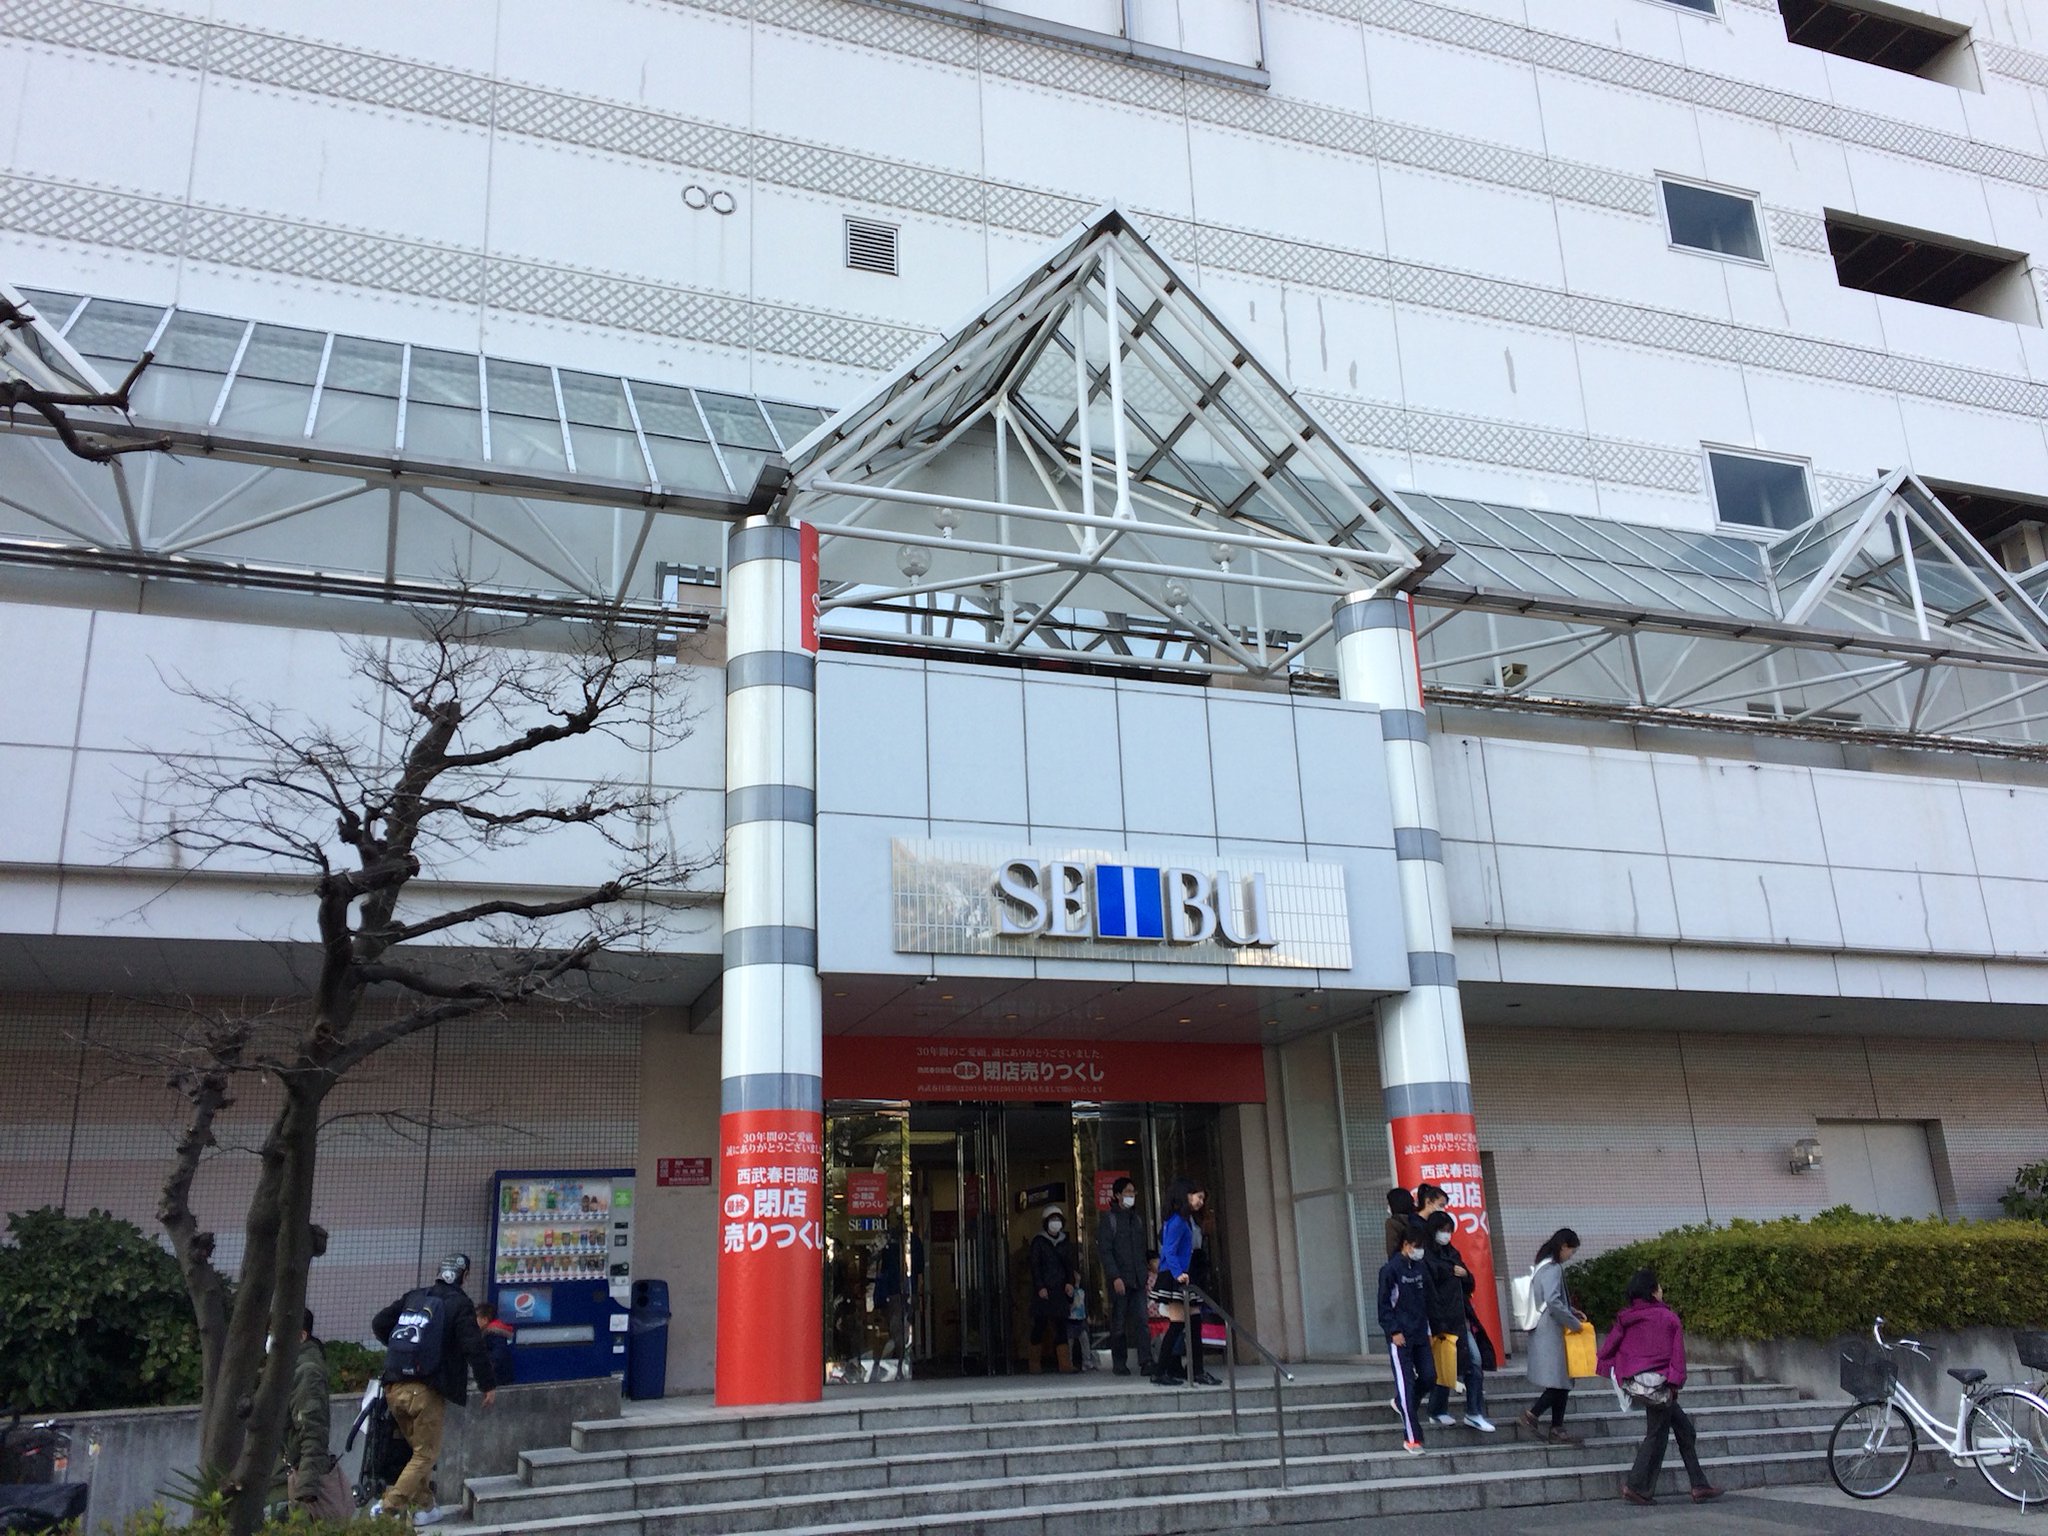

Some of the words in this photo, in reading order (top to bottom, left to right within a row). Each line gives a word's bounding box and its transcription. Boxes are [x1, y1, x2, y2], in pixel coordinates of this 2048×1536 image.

[998, 858, 1275, 947] SEIBU
[982, 1061, 1105, 1082] 閉店売りつくし
[726, 1143, 822, 1157] 誠にありがとうございまし
[737, 1167, 818, 1185] 西武春日部店
[726, 1197, 747, 1215] 最終
[753, 1188, 807, 1218] 閉店
[848, 1218, 888, 1231] SEIBU
[724, 1221, 824, 1253] 売りつくし
